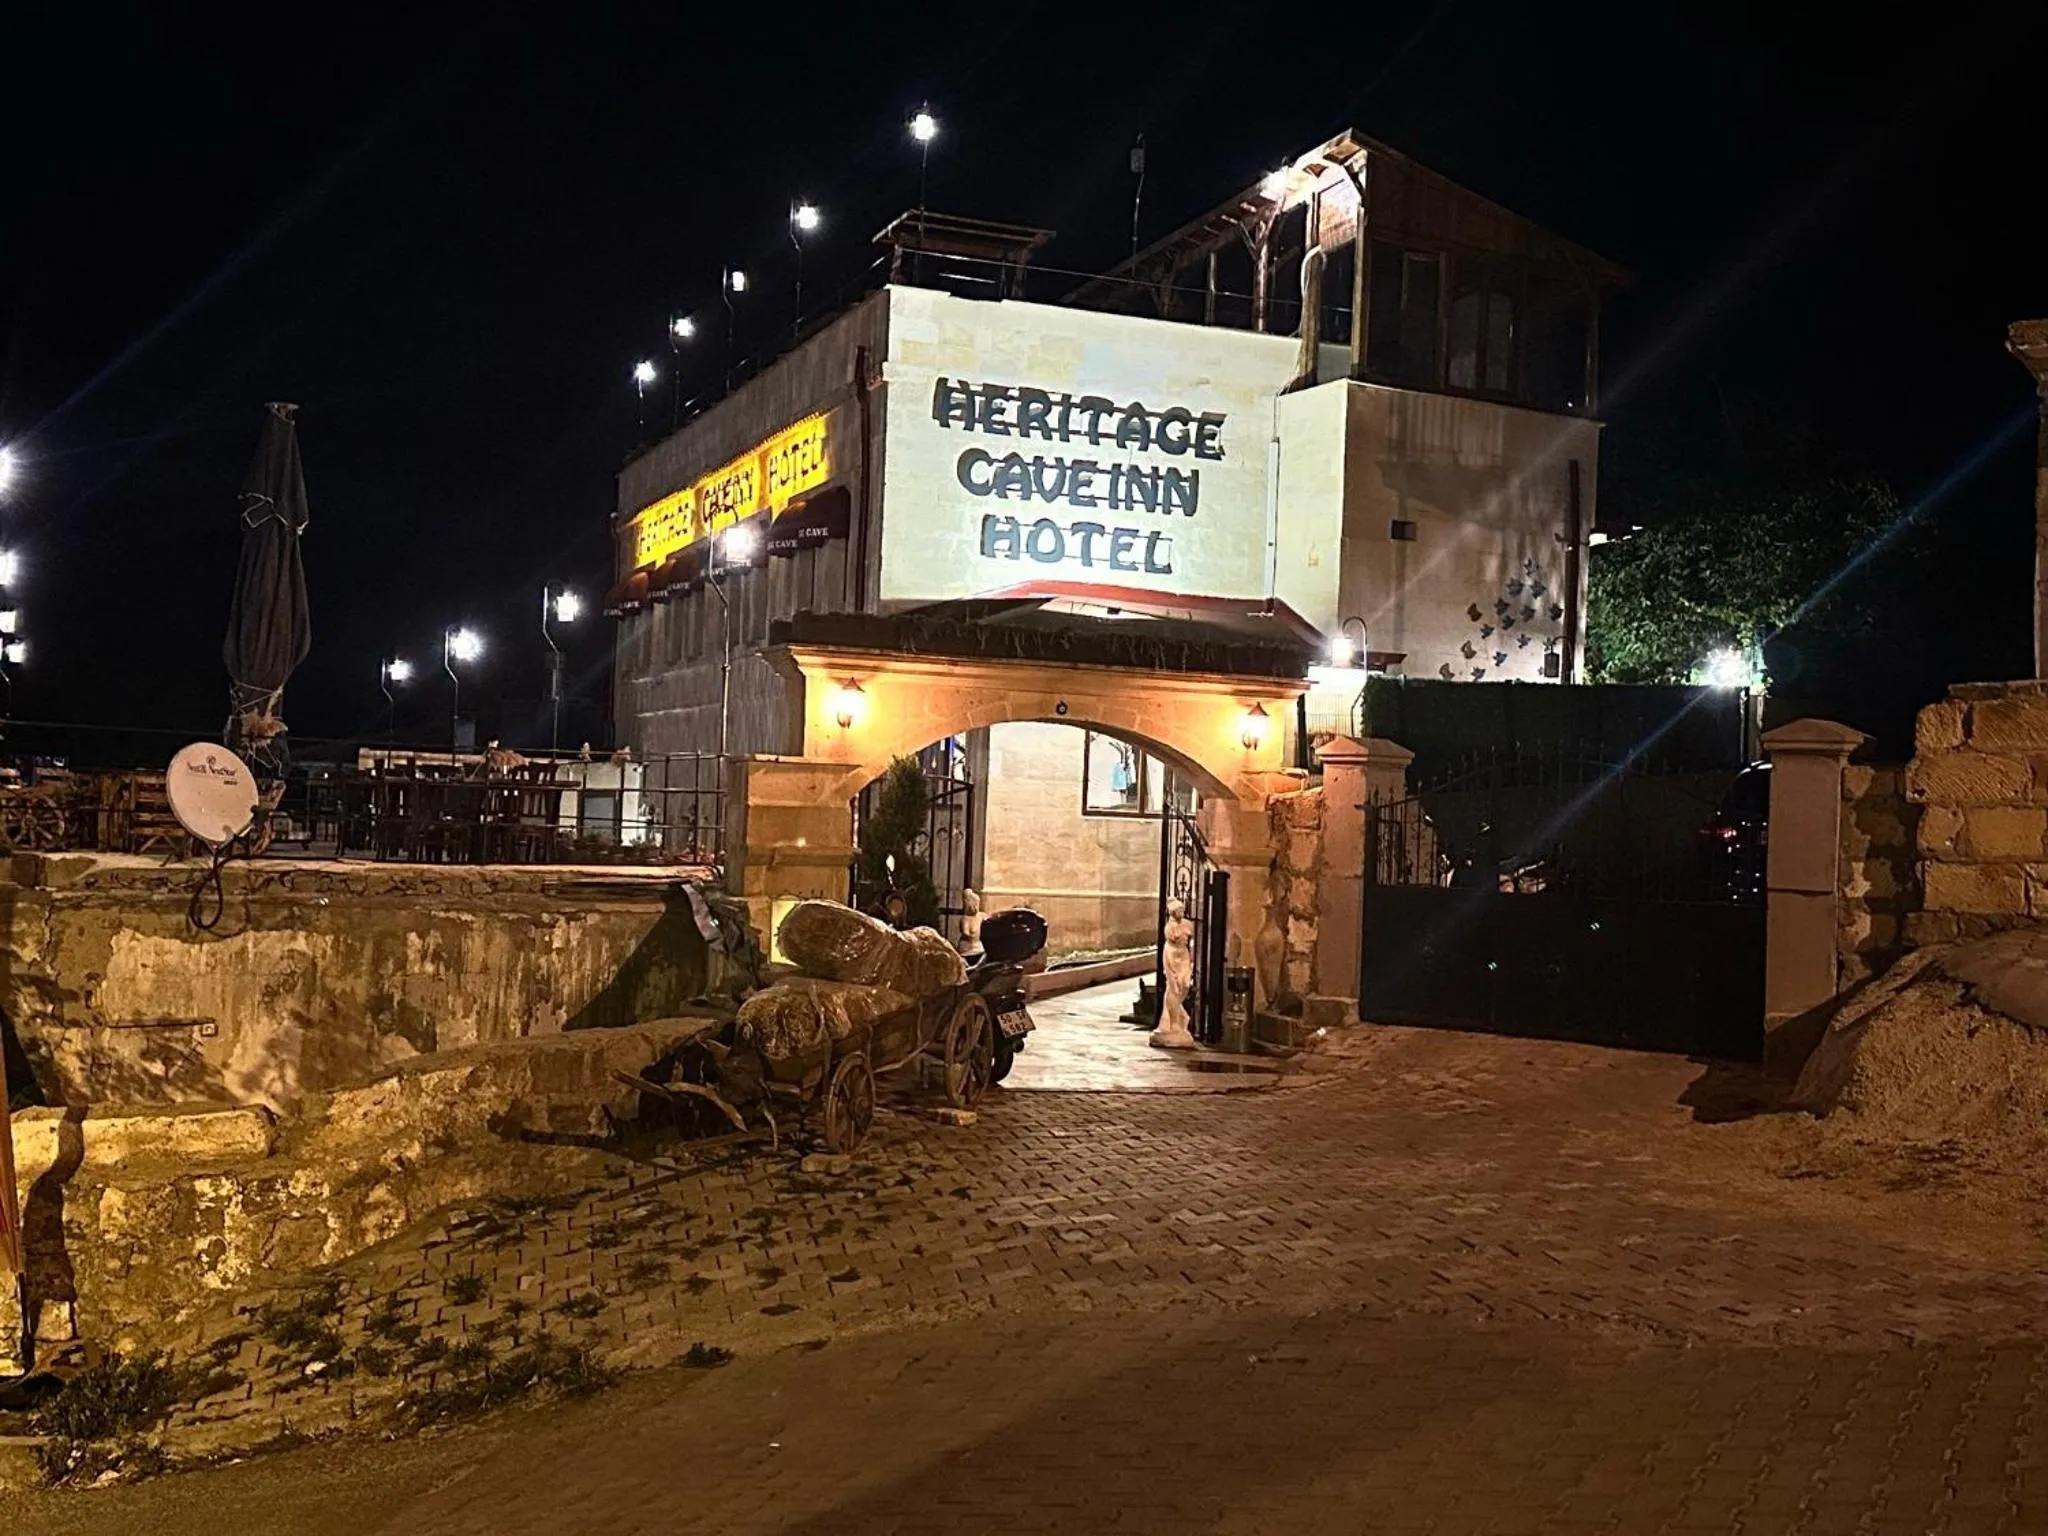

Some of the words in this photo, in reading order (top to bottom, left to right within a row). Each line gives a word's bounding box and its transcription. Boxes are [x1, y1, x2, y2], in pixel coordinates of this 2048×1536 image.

[932, 377, 1227, 461] HERITAGE
[775, 539, 798, 549] CAVE
[805, 526, 829, 537] CAVE
[979, 513, 1174, 575] HOTEL
